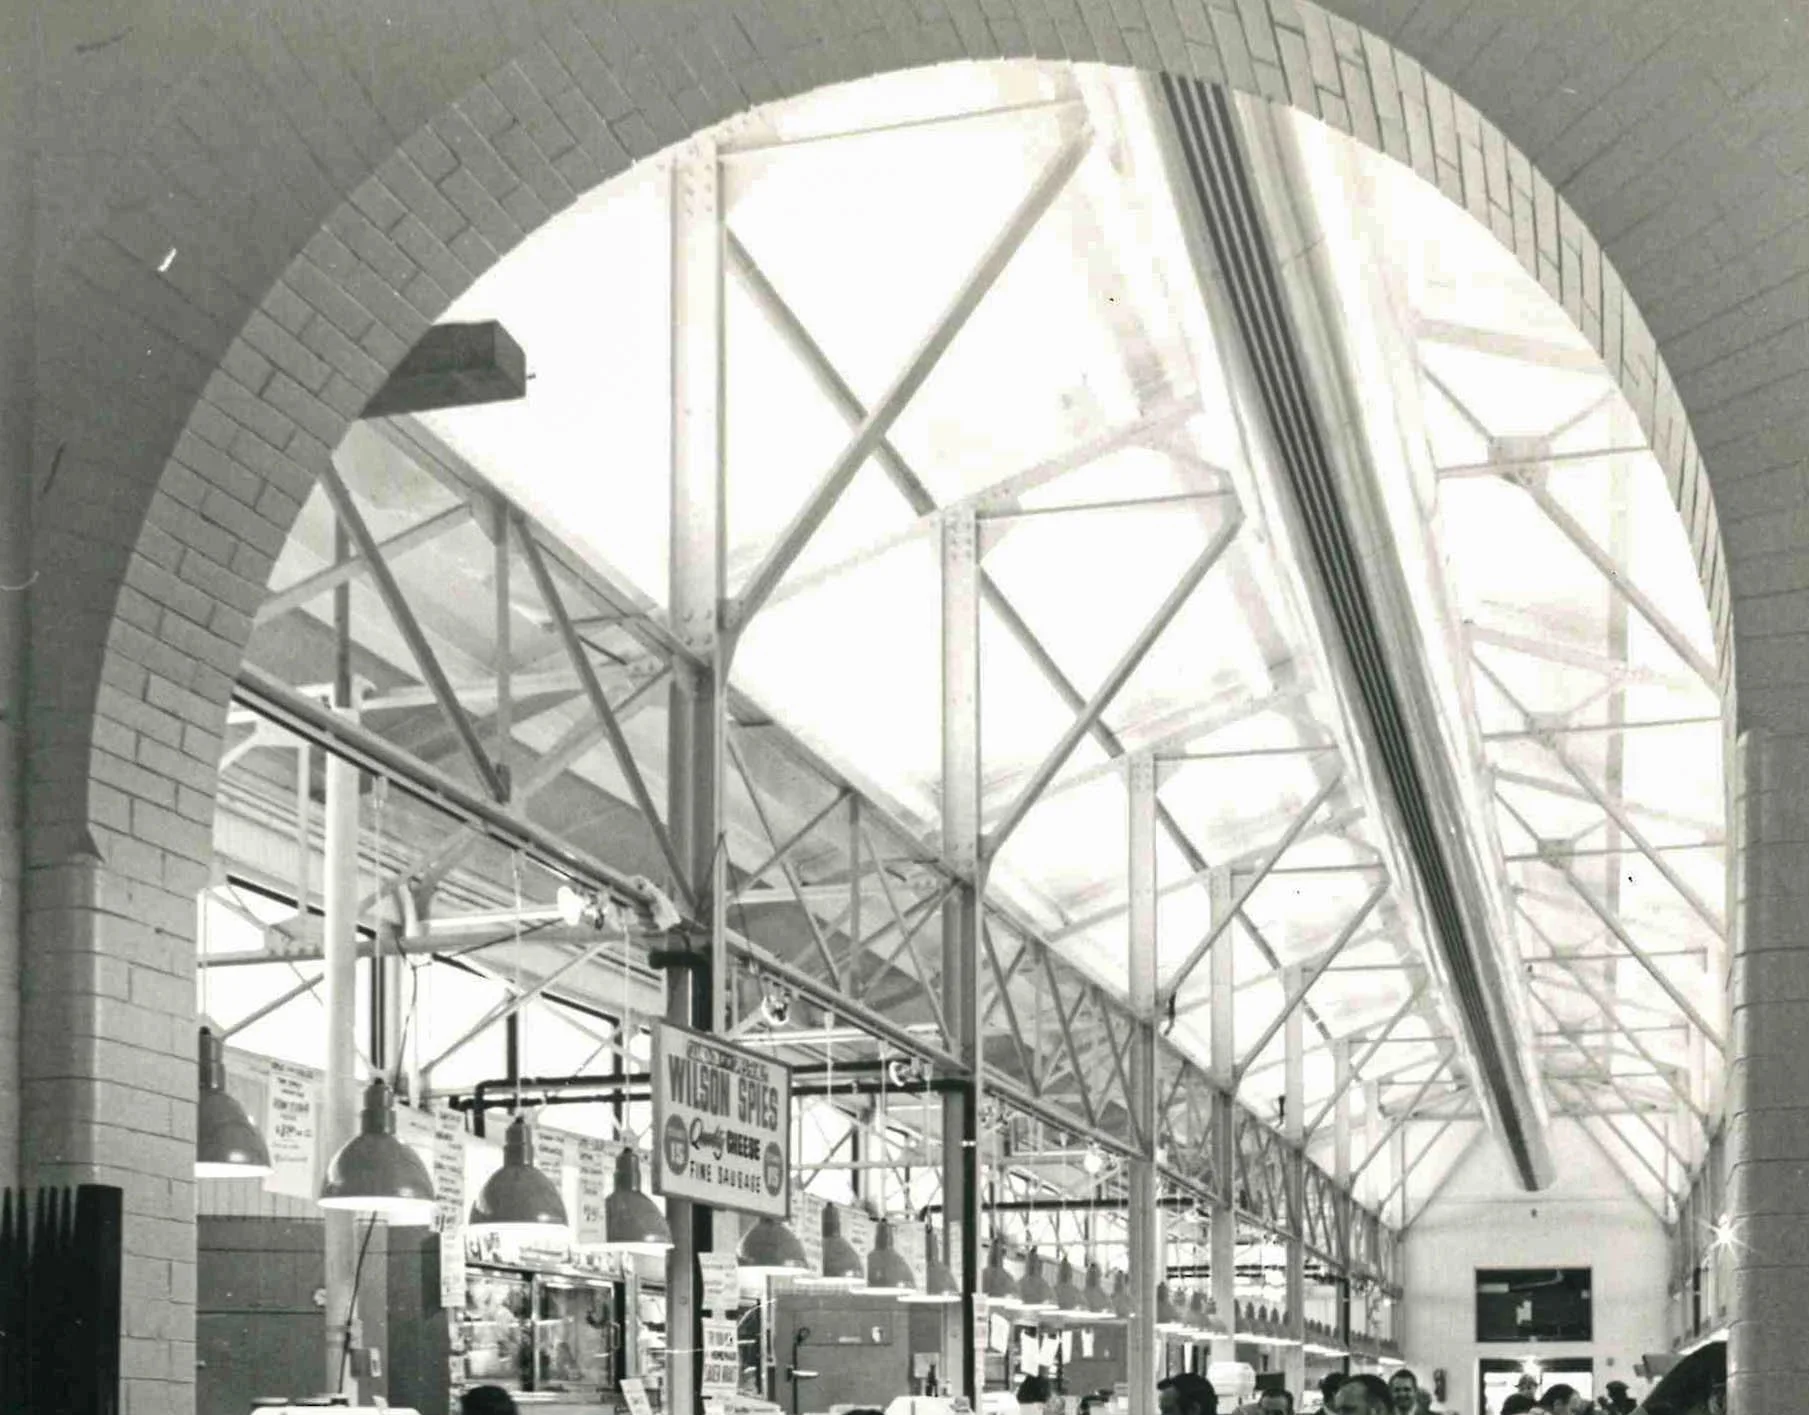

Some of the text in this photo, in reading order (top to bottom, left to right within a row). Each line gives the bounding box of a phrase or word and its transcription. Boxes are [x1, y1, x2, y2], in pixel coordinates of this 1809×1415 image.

[668, 1054, 731, 1118] WILSON
[738, 1077, 779, 1132] SPIES
[726, 1130, 761, 1161] CHEESE
[689, 1160, 712, 1184] FINE
[717, 1165, 761, 1194] SAUSAGE
